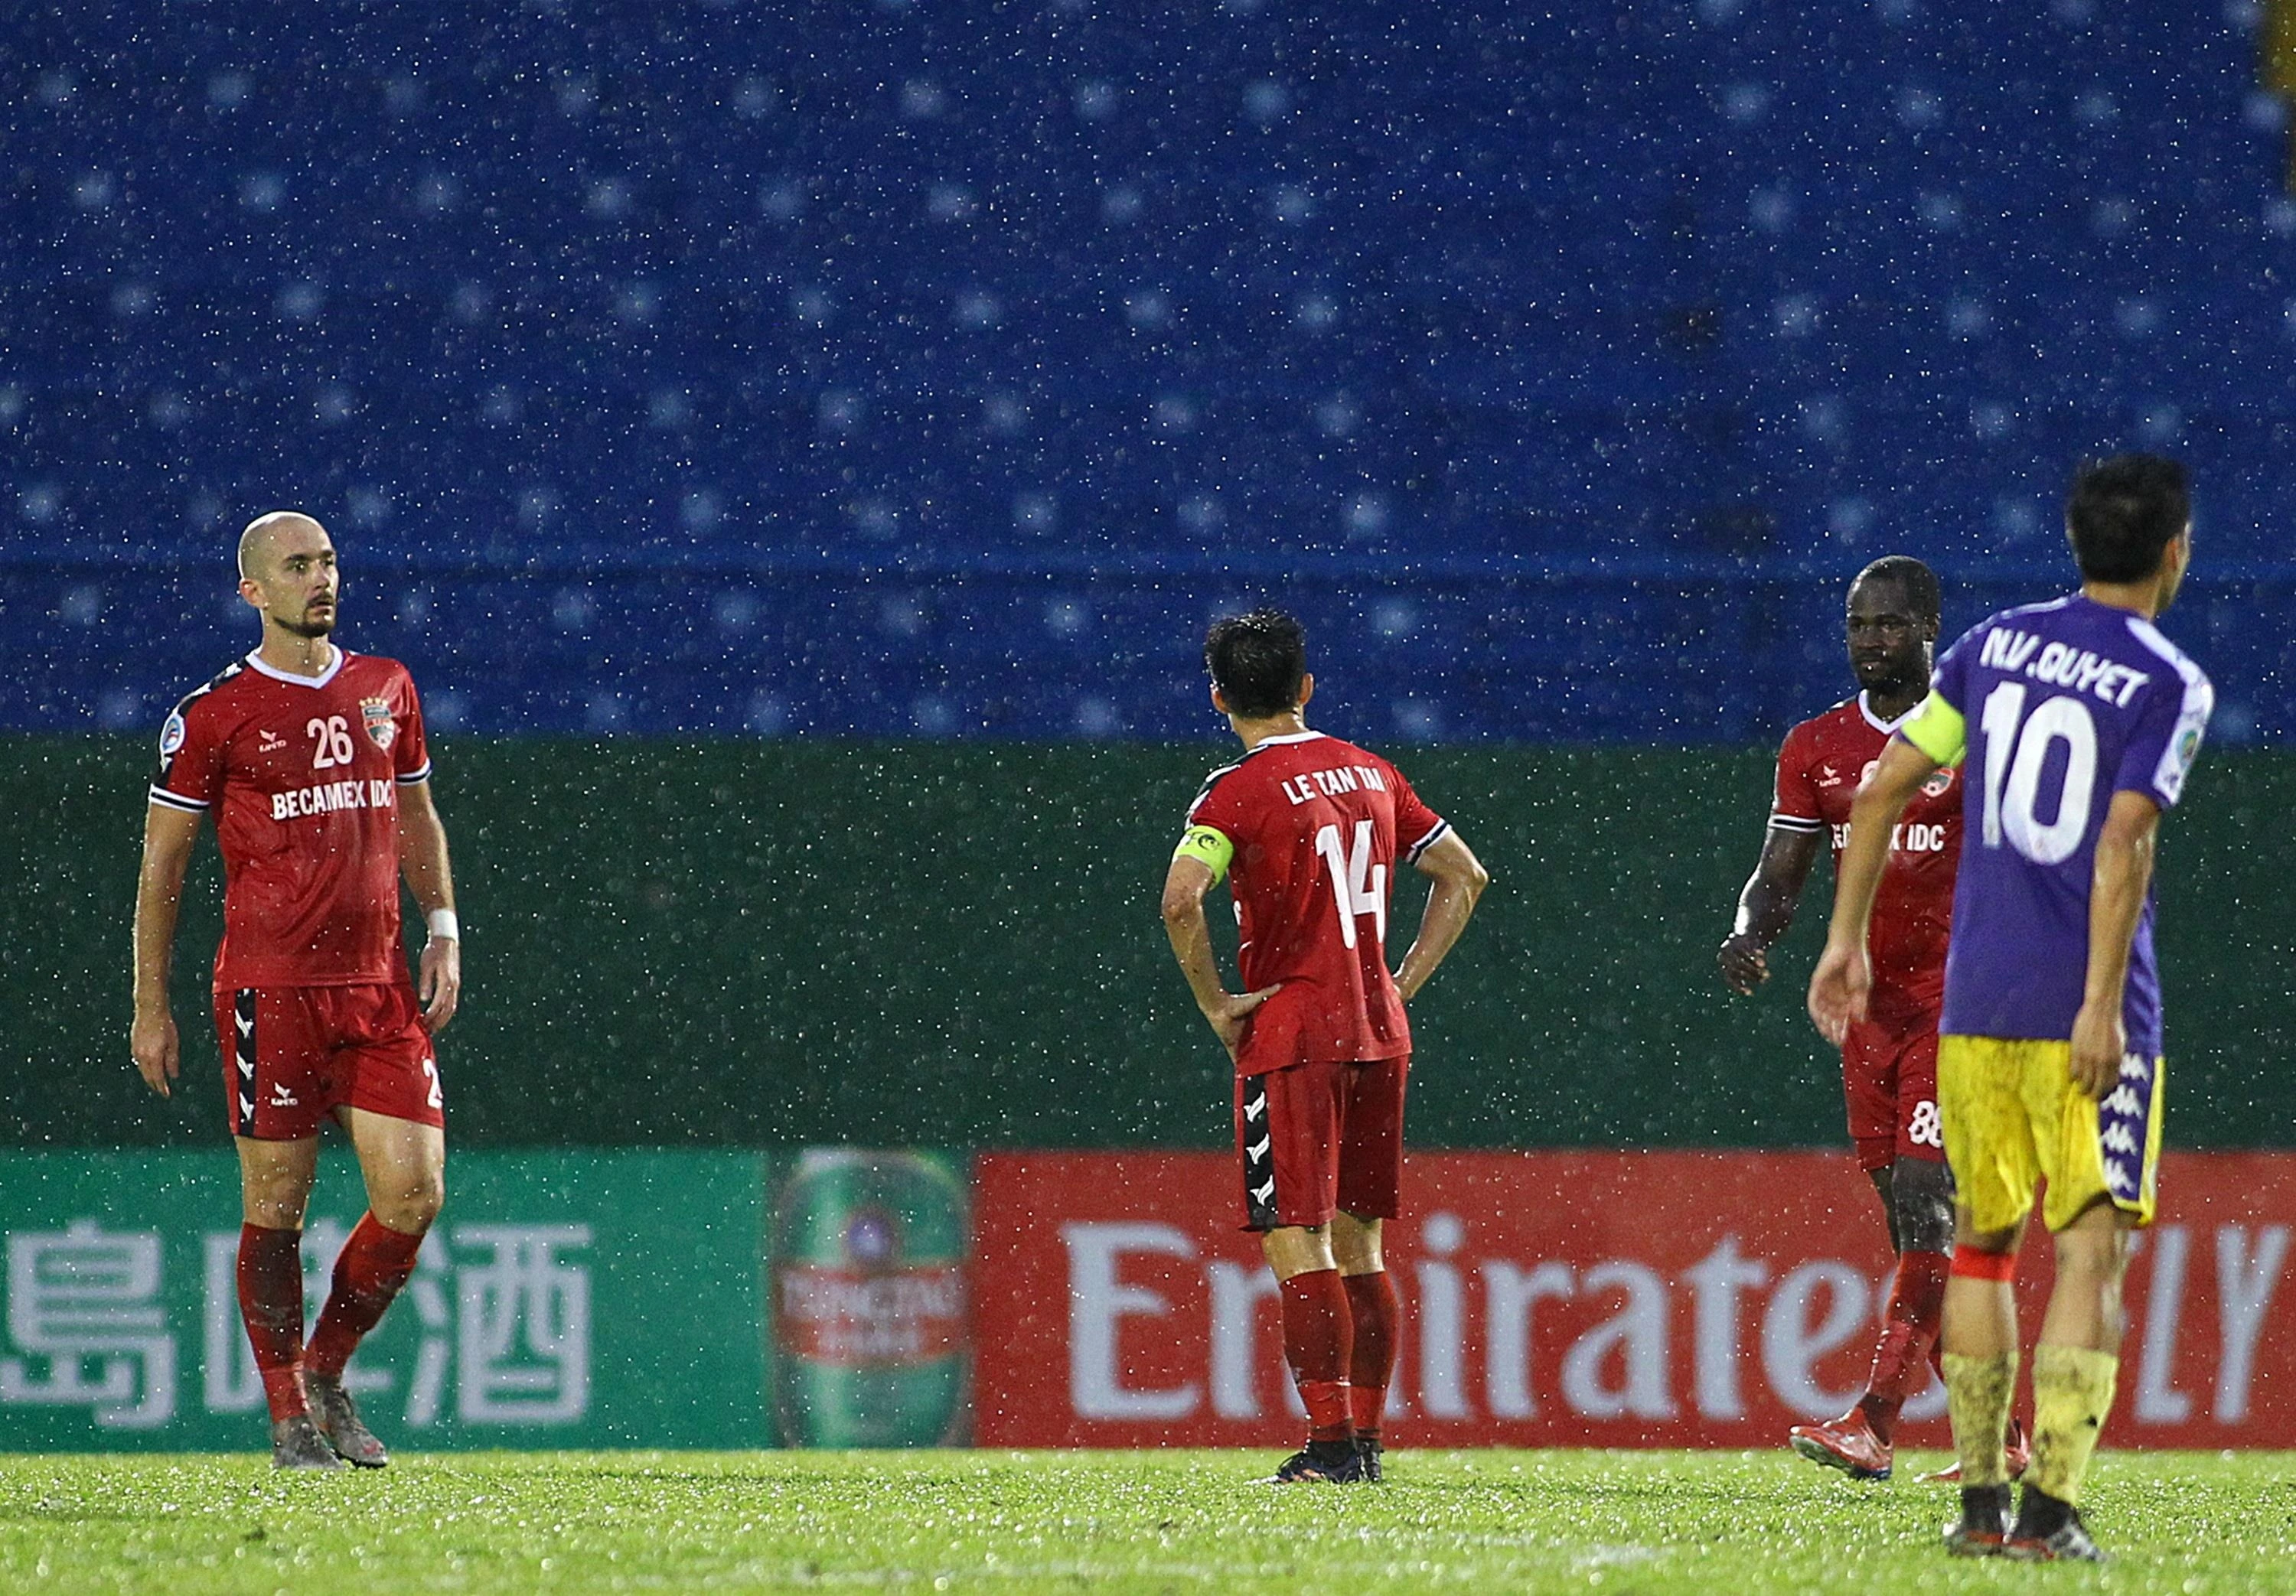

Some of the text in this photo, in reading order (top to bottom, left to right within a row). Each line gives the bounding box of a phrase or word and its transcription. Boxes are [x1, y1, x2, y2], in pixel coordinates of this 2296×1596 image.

[307, 715, 354, 769] 26
[1281, 774, 1316, 806] LE
[1311, 766, 1358, 796] TAN
[1981, 680, 2099, 866] 10
[272, 779, 393, 821] BECAMEX IDC
[1906, 823, 1945, 852] IDC
[1315, 820, 1387, 950] 14
[422, 1058, 443, 1109] 2
[2117, 1223, 2291, 1426] LY
